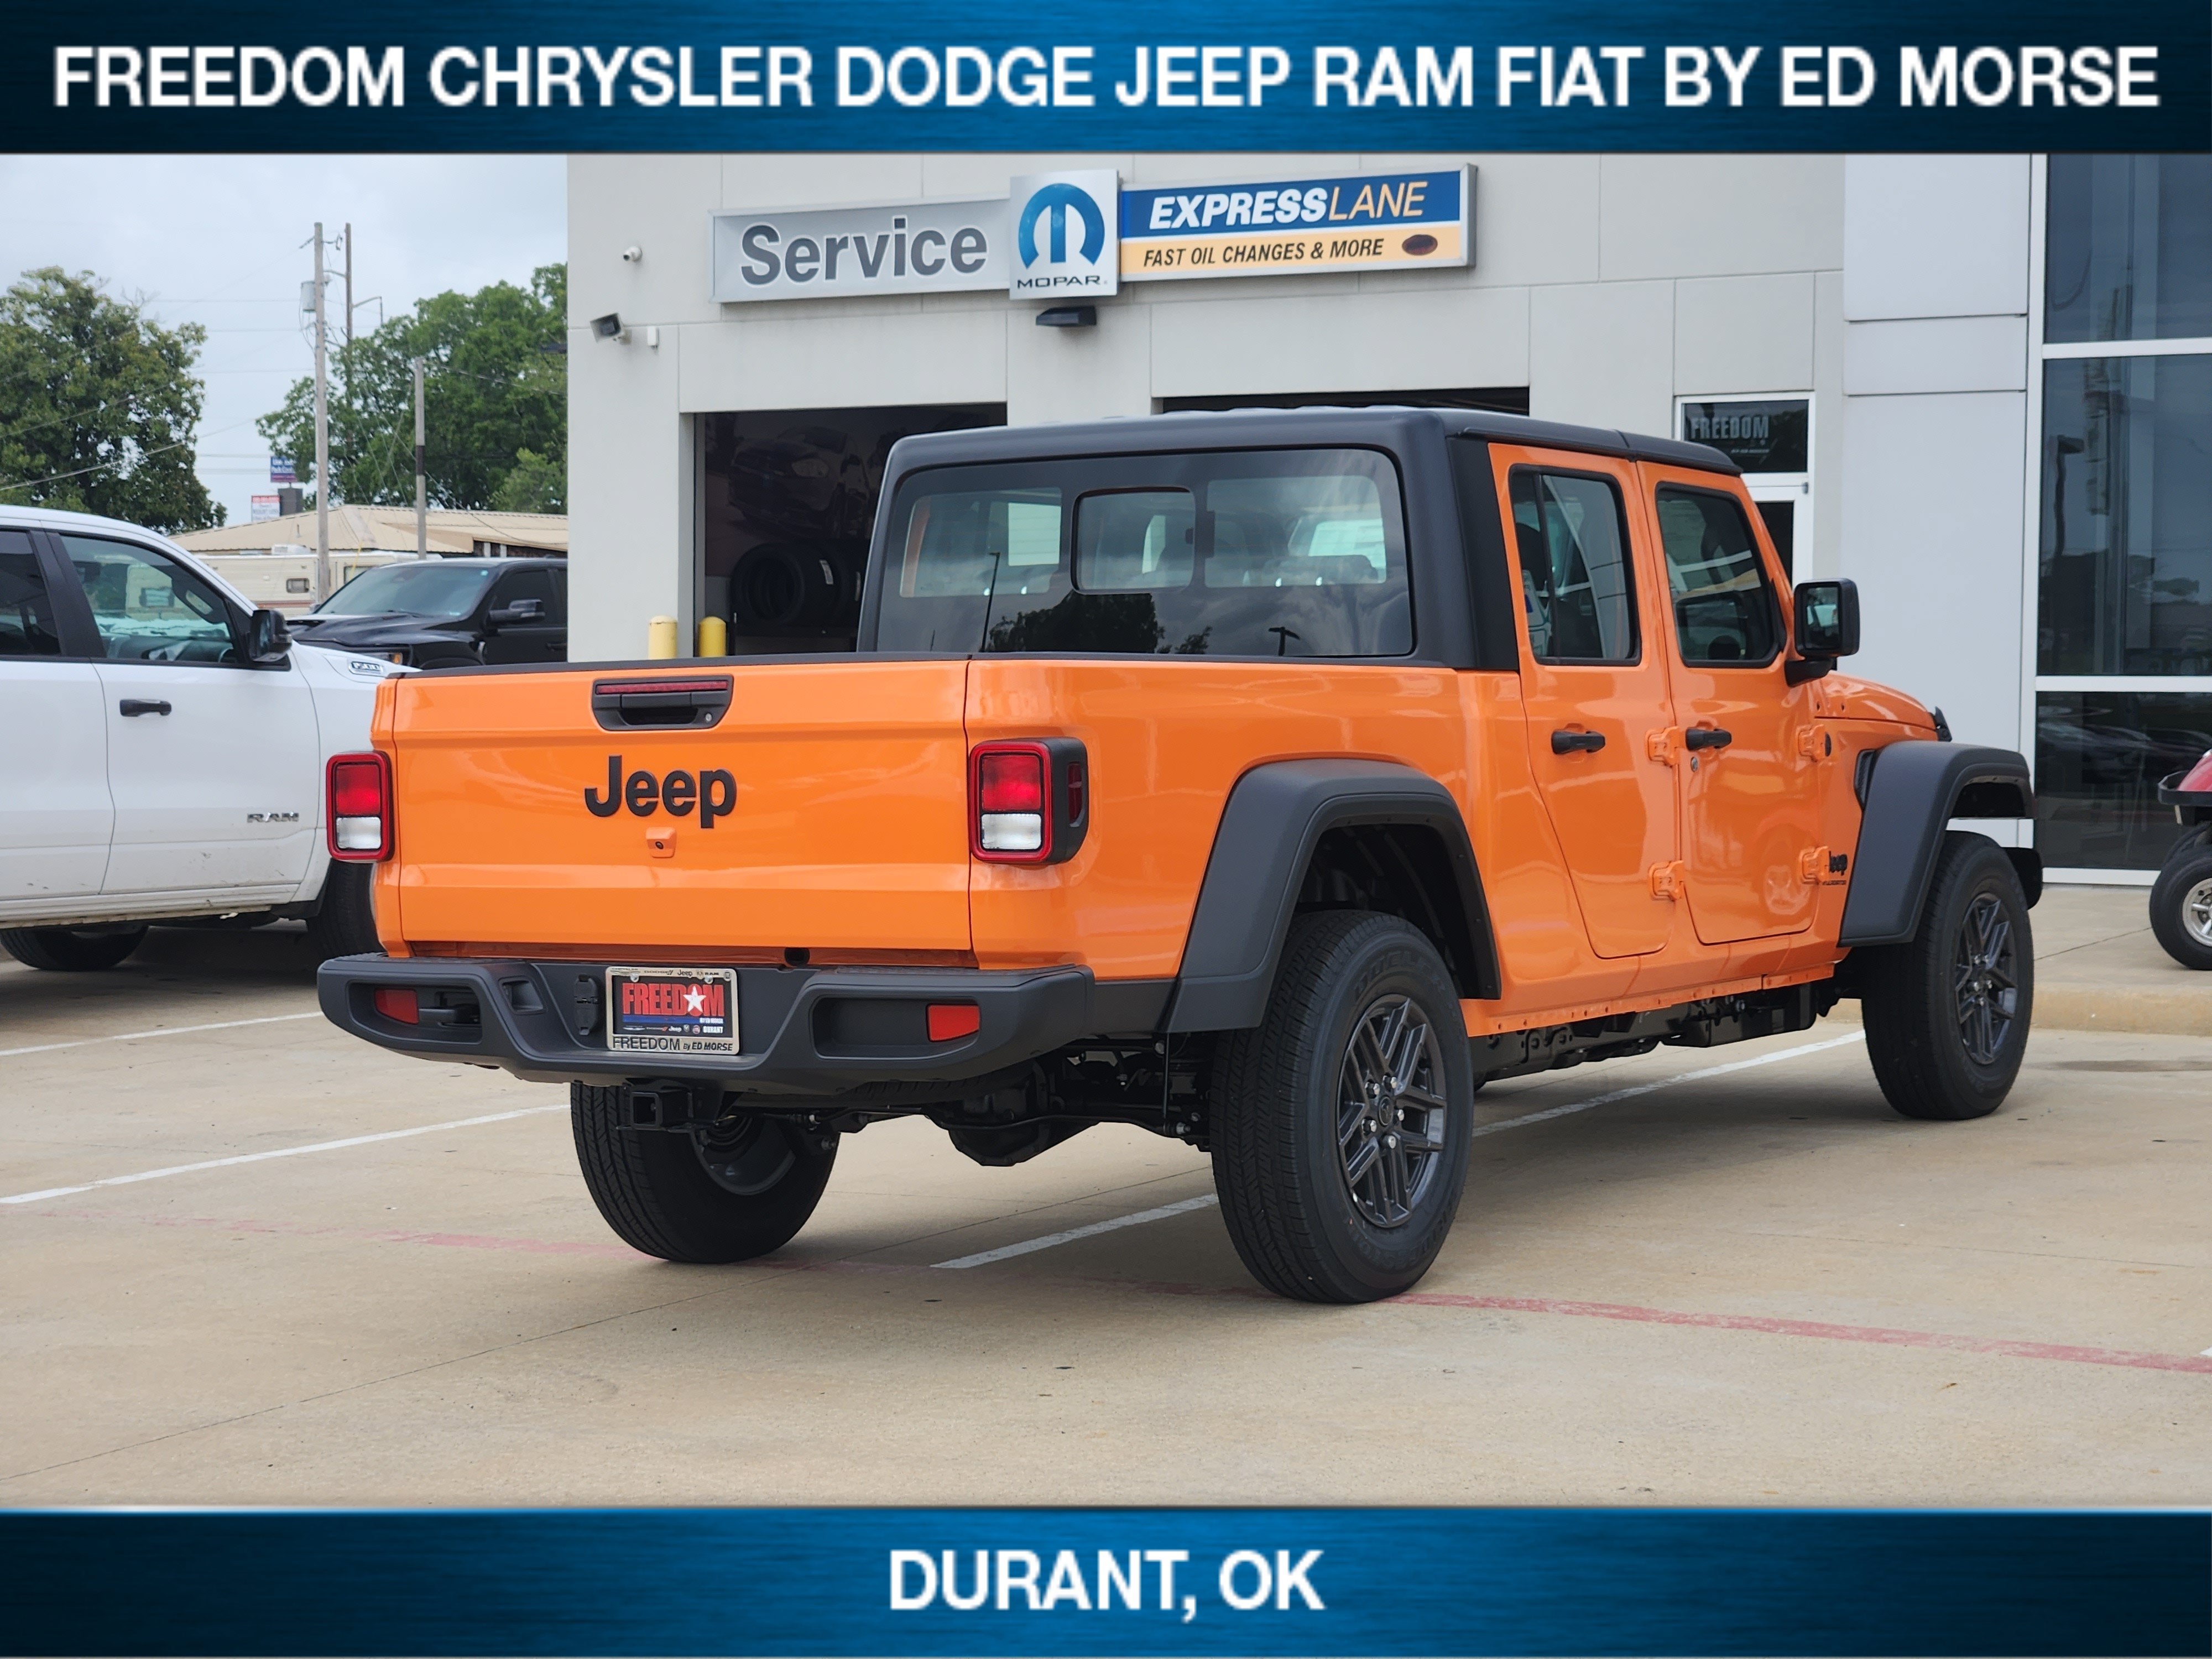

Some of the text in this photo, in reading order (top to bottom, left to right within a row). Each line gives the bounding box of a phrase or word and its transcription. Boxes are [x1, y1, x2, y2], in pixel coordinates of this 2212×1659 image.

[741, 216, 988, 286] Service
[1144, 239, 1384, 268] FAST OIL CHANGES & MORE
[1018, 275, 1100, 289] MOPAR
[1690, 415, 1768, 439] FREEDOM
[585, 754, 737, 829] Jeep
[247, 813, 299, 823] RAM
[677, 969, 692, 977] Jeep
[622, 983, 724, 1016] FREEDOM
[613, 1036, 680, 1050] FREEDOM
[705, 1042, 733, 1051] MORSE
